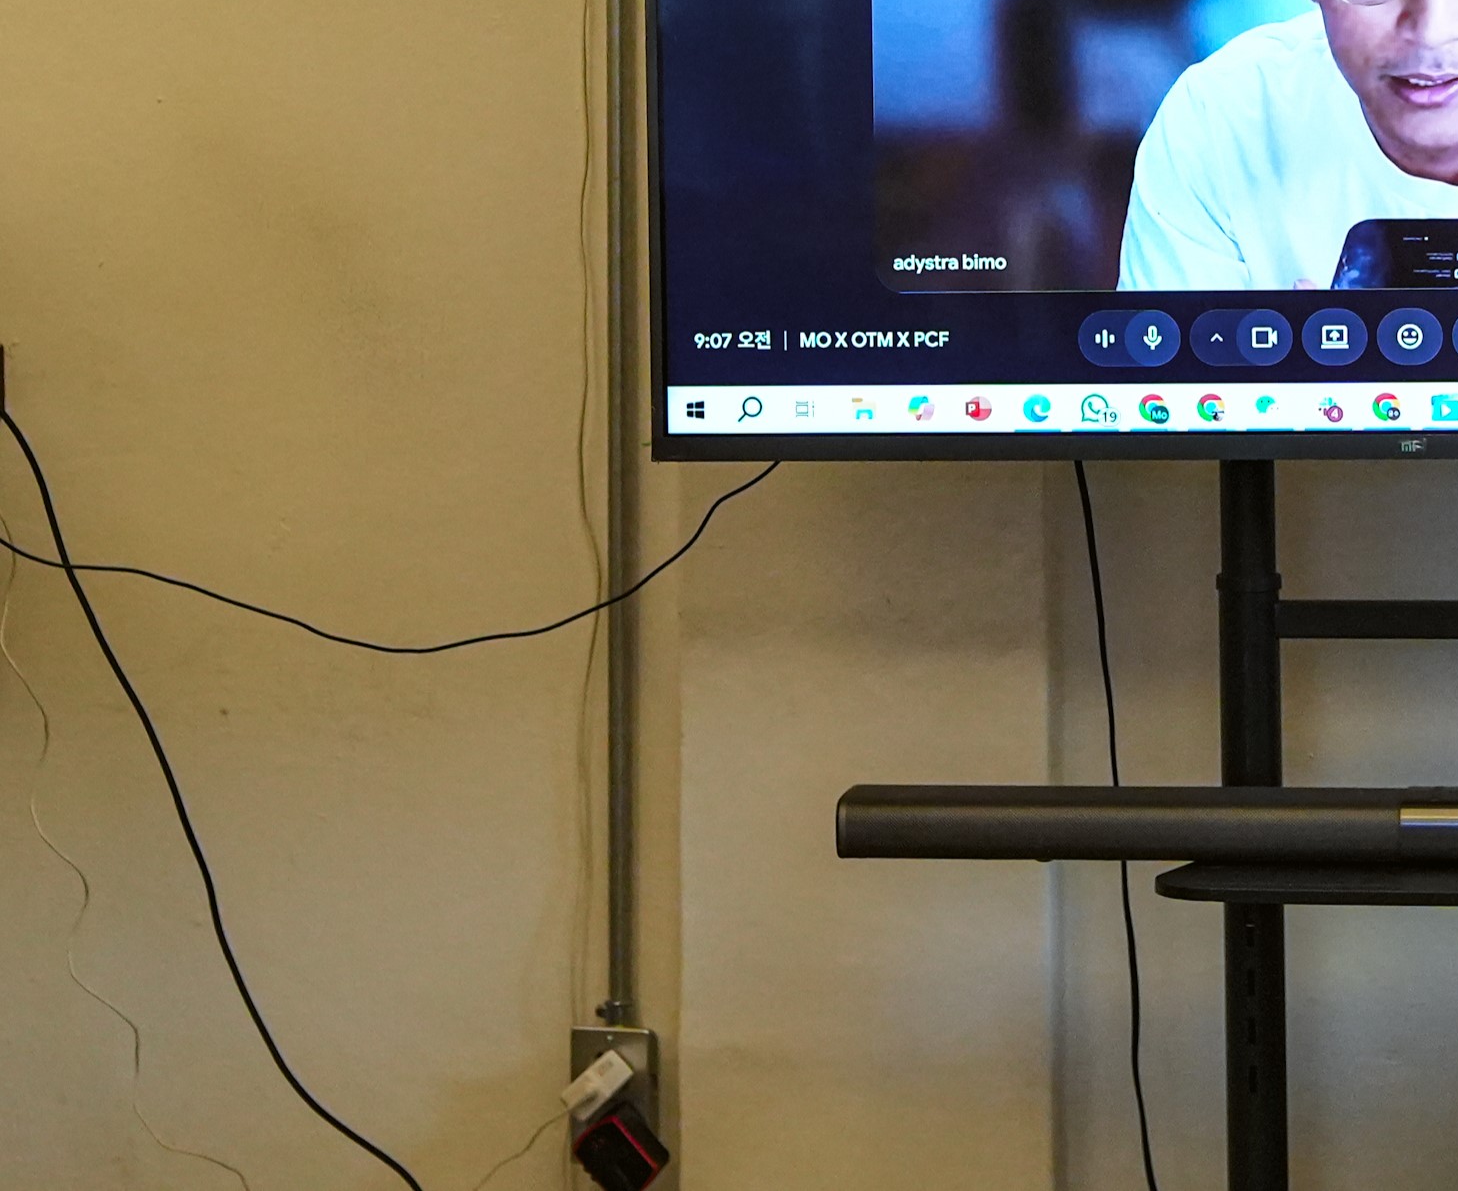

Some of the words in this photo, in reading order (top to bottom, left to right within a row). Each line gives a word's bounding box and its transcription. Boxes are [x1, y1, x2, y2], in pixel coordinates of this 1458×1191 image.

[893, 254, 959, 275] adystra
[962, 253, 1007, 270] bimo
[693, 332, 733, 350] 9:07
[737, 330, 771, 350] 오전
[799, 332, 832, 348] MO
[834, 331, 849, 348] X
[851, 331, 894, 348] OTM
[896, 331, 911, 348] X
[913, 331, 950, 348] PCF
[1103, 411, 1117, 423] 19
[1152, 410, 1168, 420] Mo
